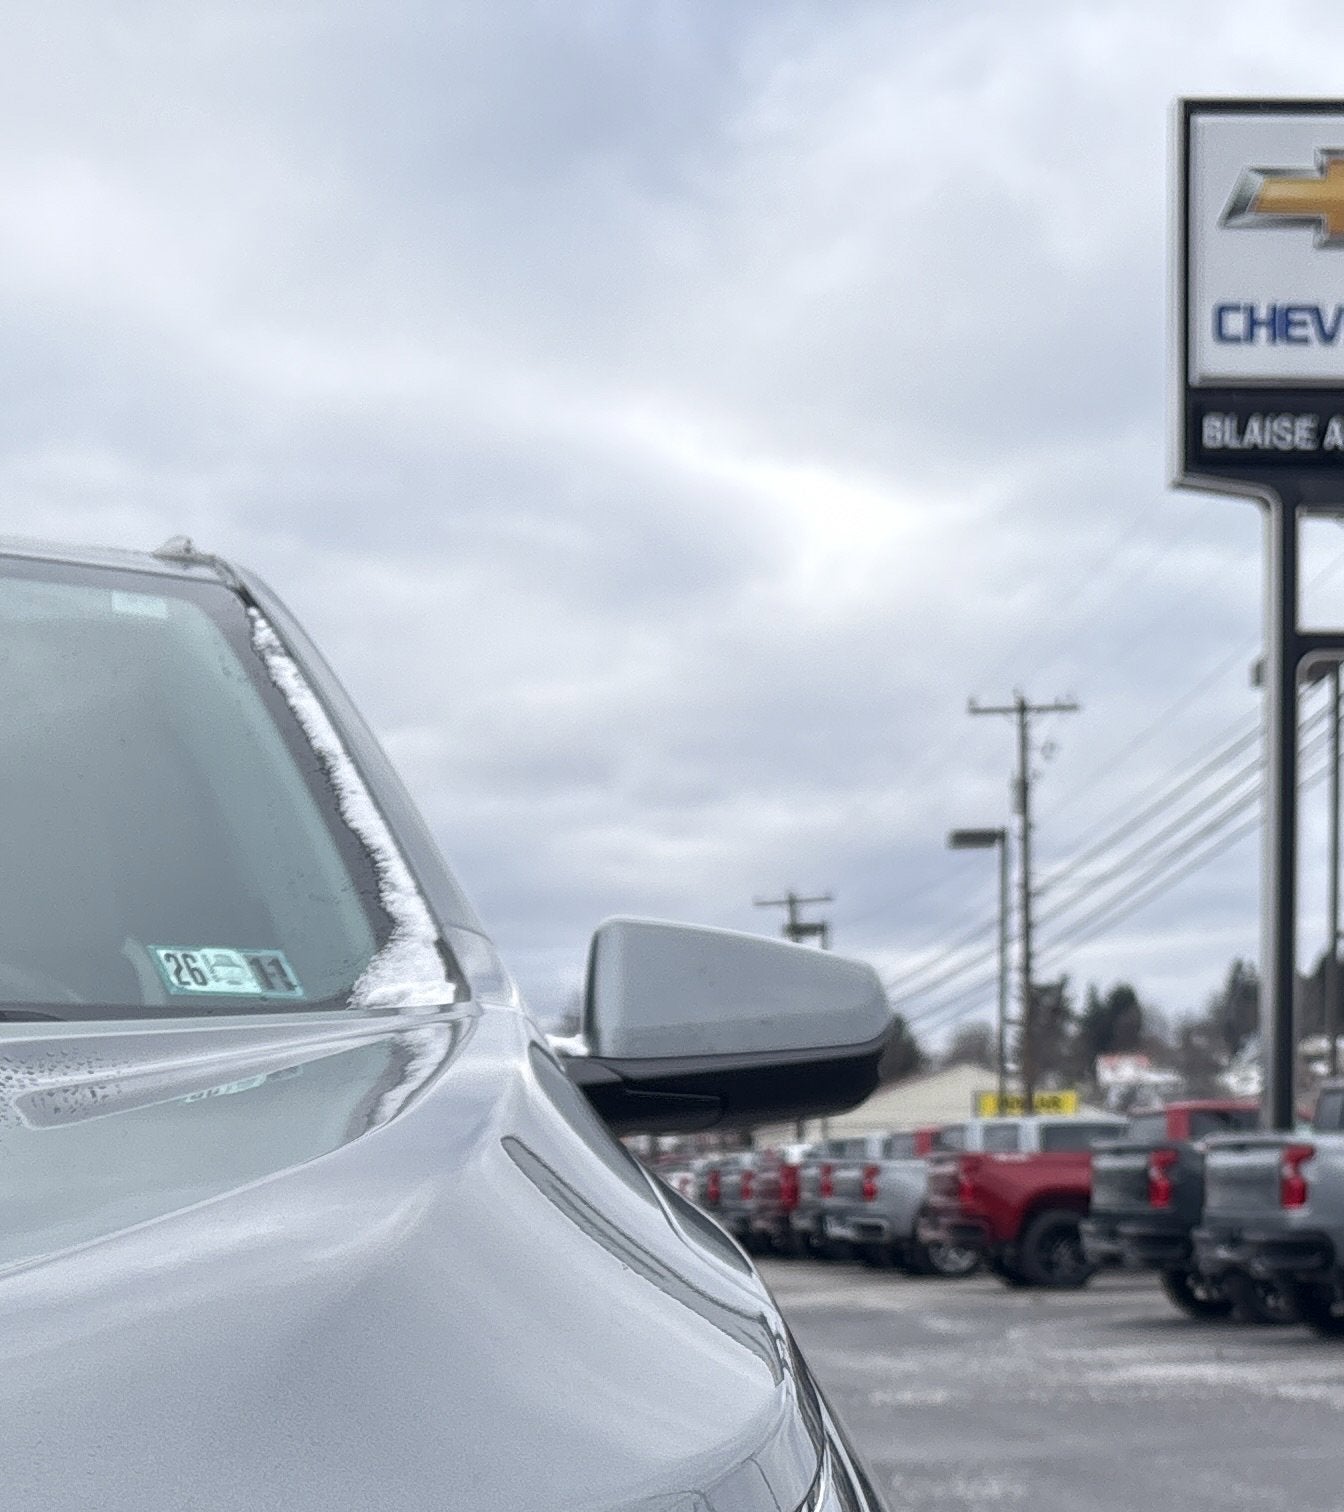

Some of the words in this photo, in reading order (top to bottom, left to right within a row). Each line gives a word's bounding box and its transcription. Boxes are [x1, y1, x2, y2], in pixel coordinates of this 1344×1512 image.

[1202, 414, 1318, 451] BLAISE
[164, 953, 208, 986] 26
[251, 957, 297, 991] 11
